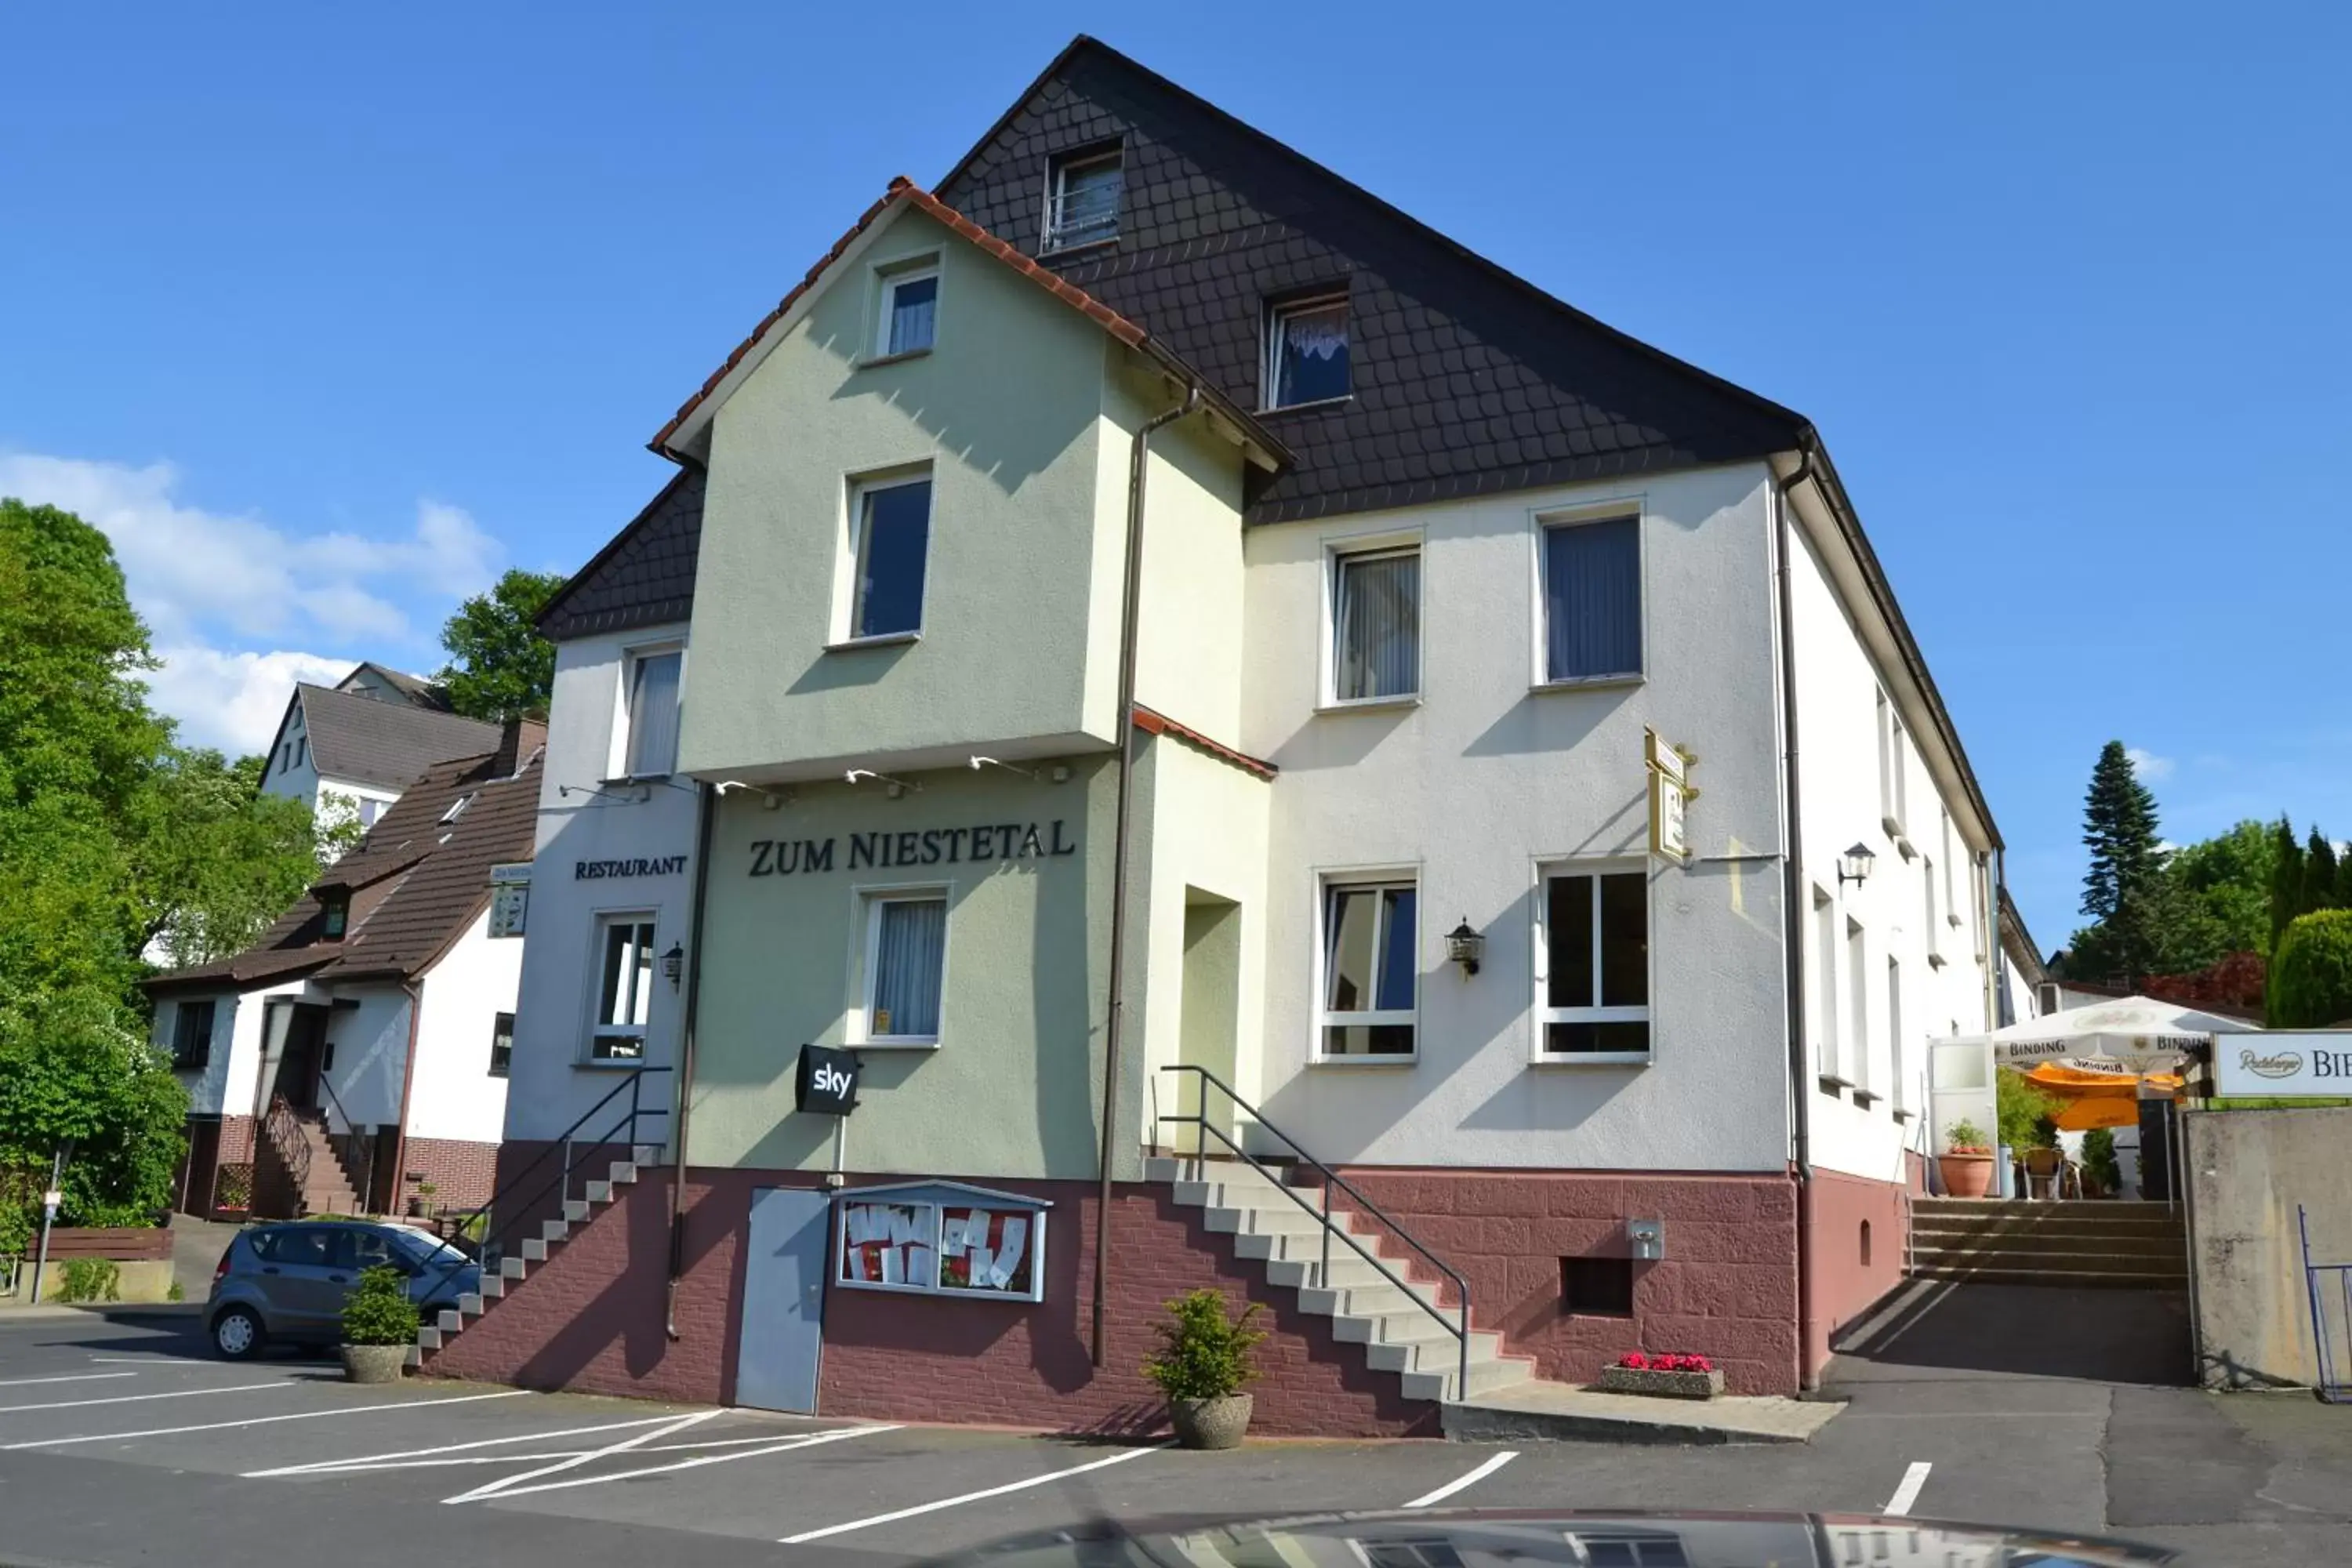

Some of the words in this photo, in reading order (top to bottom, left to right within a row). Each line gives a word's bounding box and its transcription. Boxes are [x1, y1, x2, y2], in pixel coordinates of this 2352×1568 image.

[749, 837, 836, 877] ZUM
[847, 819, 1076, 871] NIESTETAL
[575, 855, 688, 880] RESTAURANT
[2009, 1040, 2066, 1056] BINDING
[2157, 1036, 2209, 1050] BINDIN
[813, 1062, 852, 1101] sky
